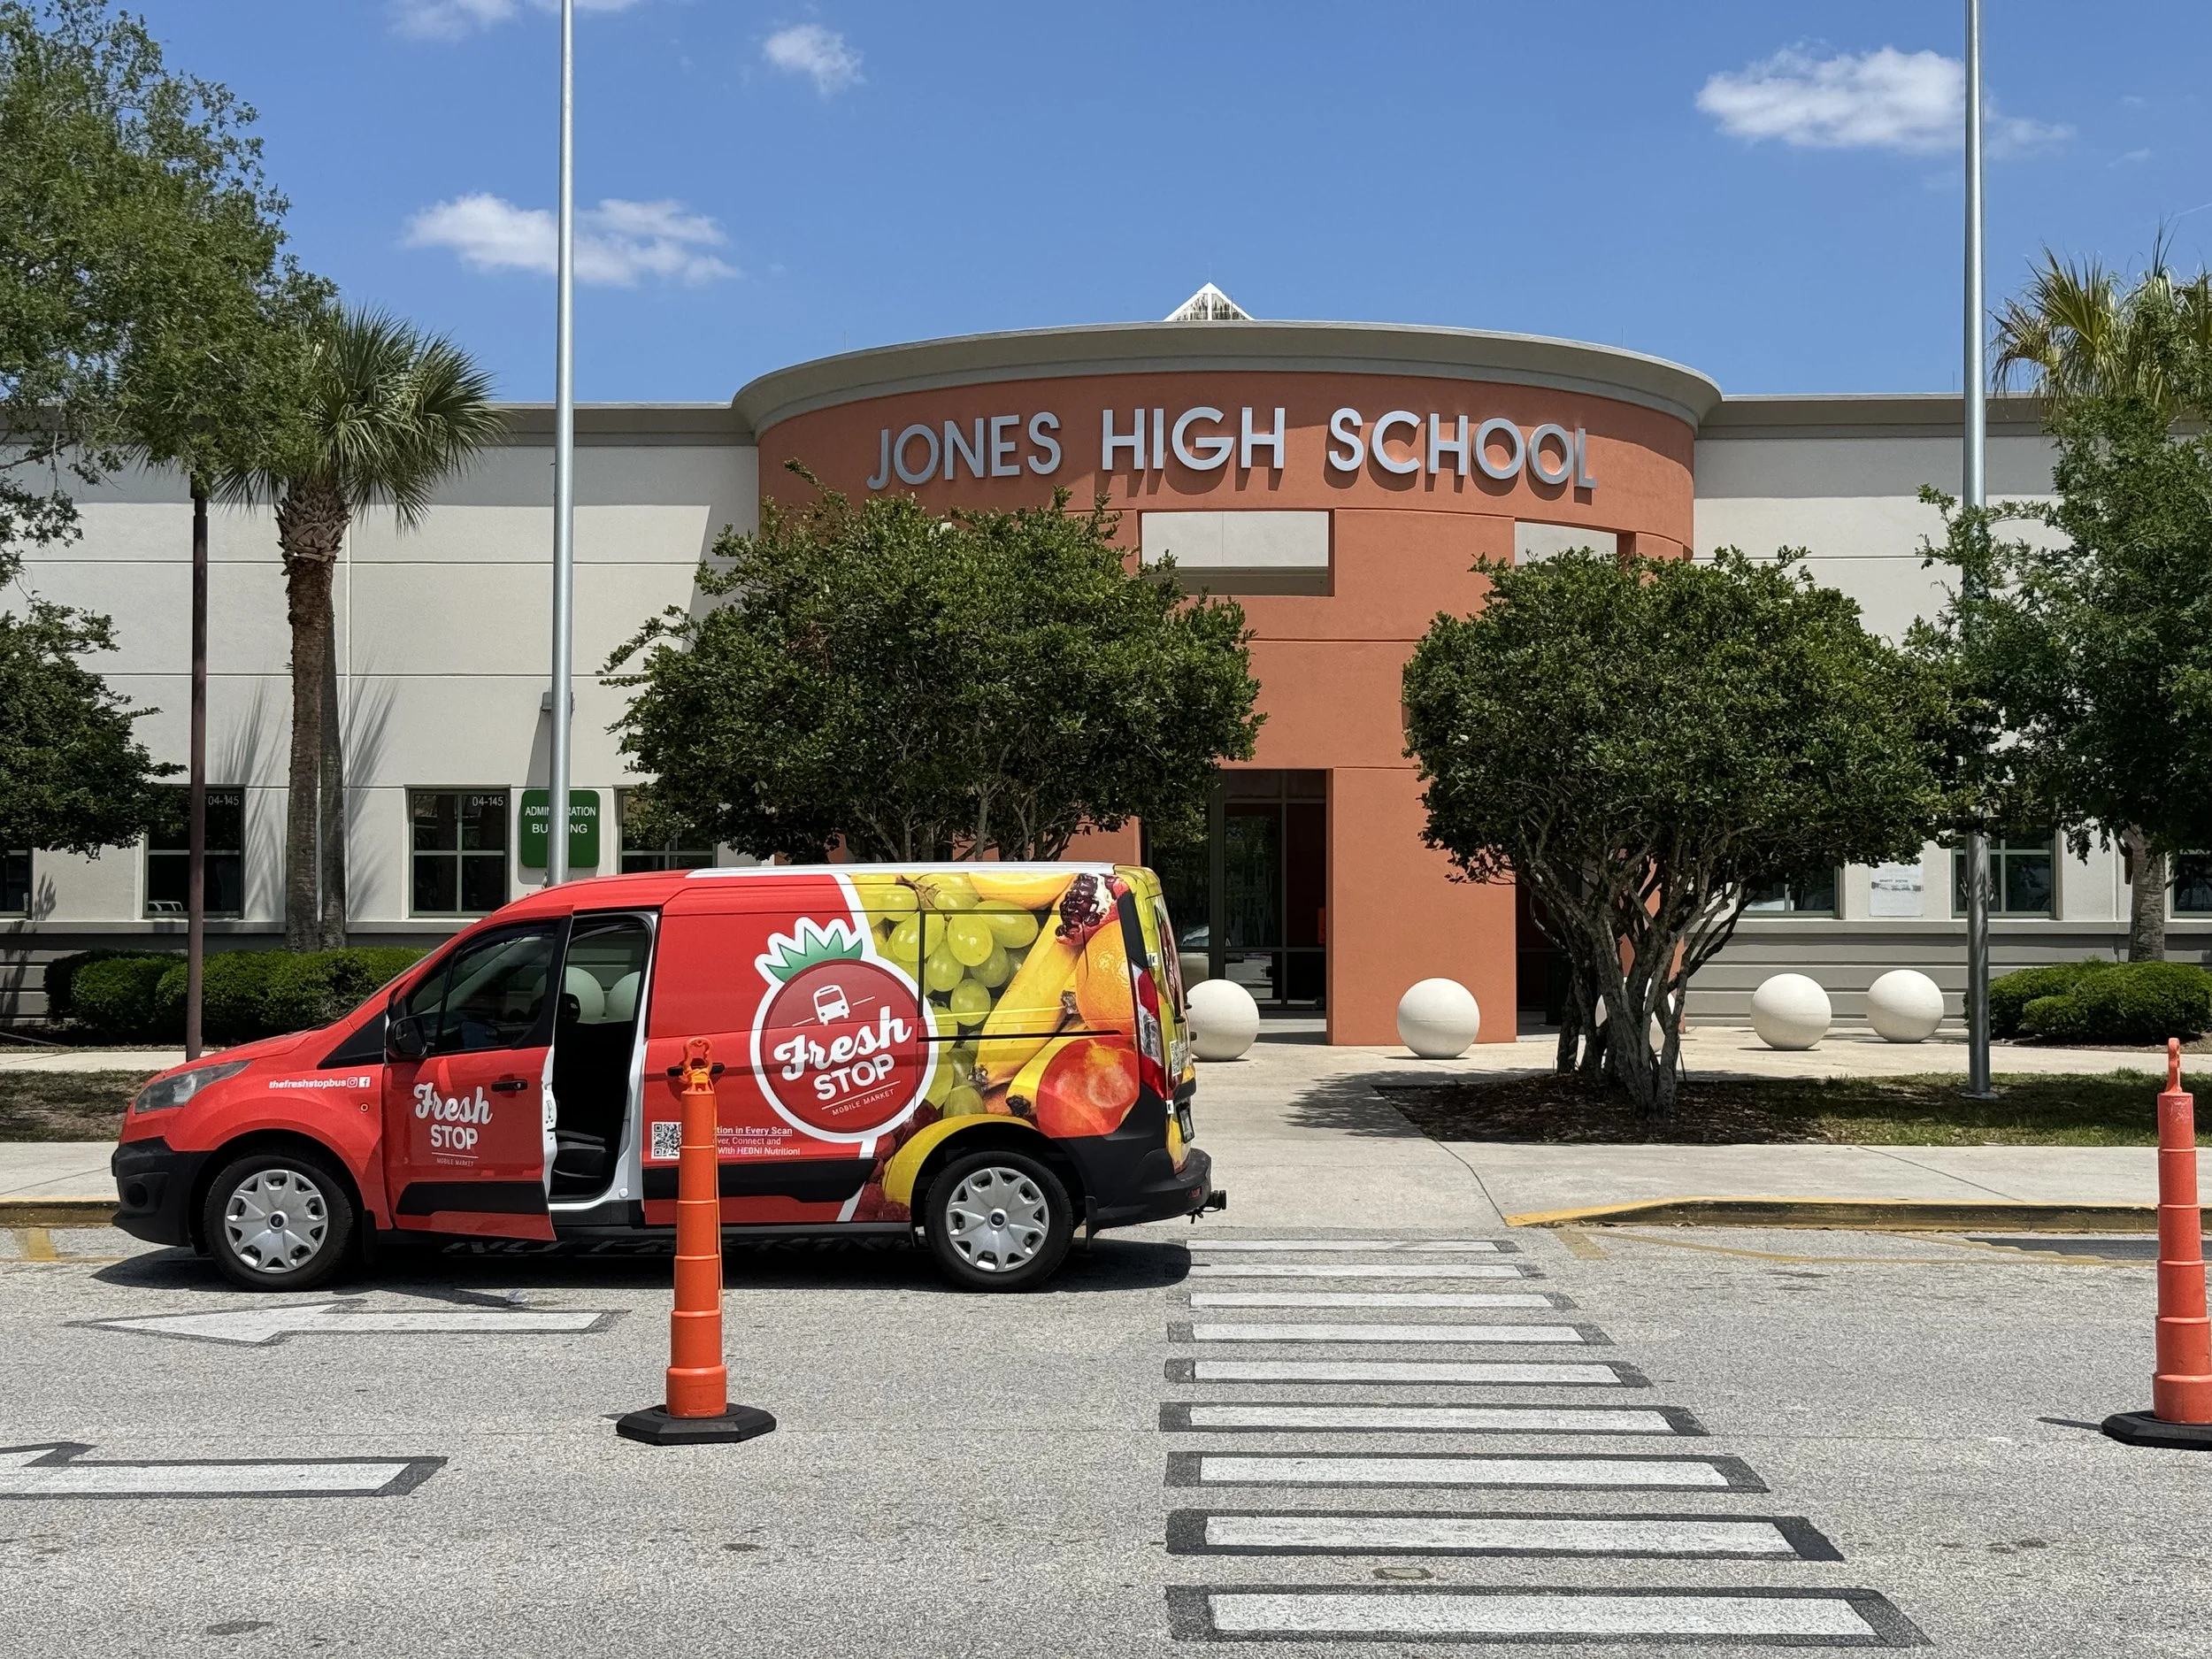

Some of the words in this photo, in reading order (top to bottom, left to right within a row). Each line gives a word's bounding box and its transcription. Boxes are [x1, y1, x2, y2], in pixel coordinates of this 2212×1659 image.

[866, 411, 1062, 490] JONES
[1102, 406, 1286, 472] HIGH
[1328, 407, 1598, 489] SCHOOL
[208, 795, 240, 806] 04-145
[472, 796, 504, 807] 04-145
[532, 823, 588, 833] BUNG
[772, 1005, 912, 1082] Fresh
[813, 1053, 895, 1101] STOP
[269, 1078, 347, 1090] thefreshstopbus
[413, 1082, 494, 1125] Fresh
[832, 1100, 862, 1117] MOBILE
[863, 1088, 895, 1104] MARKET
[717, 1125, 733, 1134] tion
[735, 1125, 744, 1134] in
[745, 1125, 770, 1136] Every
[771, 1125, 793, 1135] Scan
[430, 1124, 479, 1150] STOP
[732, 1136, 764, 1145] Connect
[718, 1147, 735, 1156] With
[764, 1147, 801, 1156] Nutrition!
